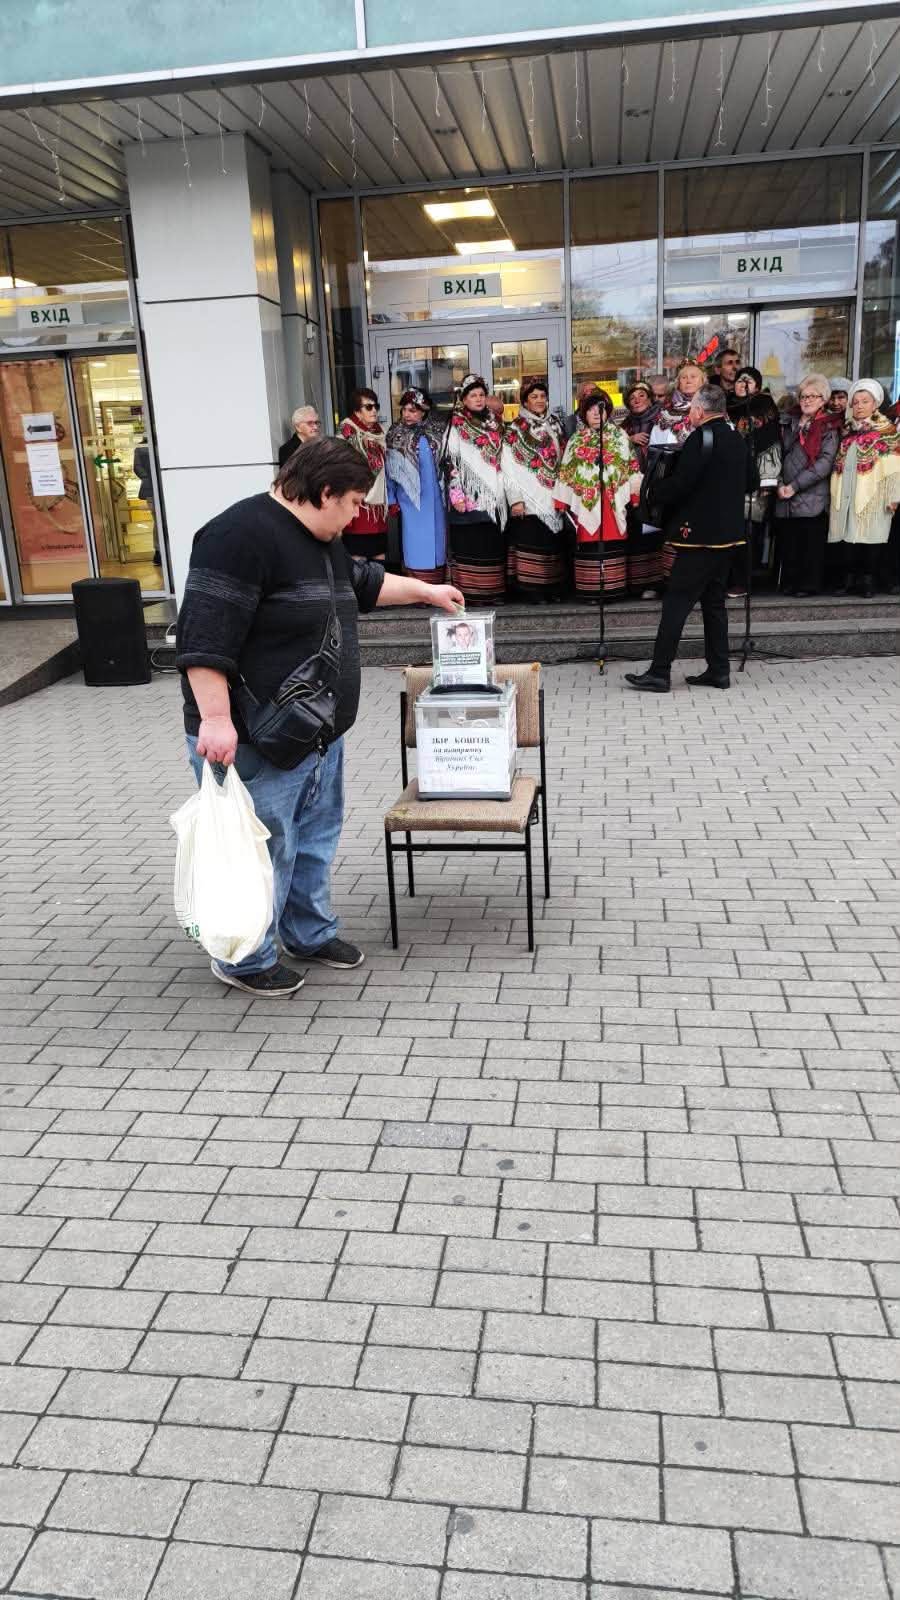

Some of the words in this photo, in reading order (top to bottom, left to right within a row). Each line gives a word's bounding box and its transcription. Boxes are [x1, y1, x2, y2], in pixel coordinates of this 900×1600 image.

[737, 256, 783, 273] ВХІД
[443, 278, 487, 295] ВХІД
[30, 308, 70, 324] ВХІД
